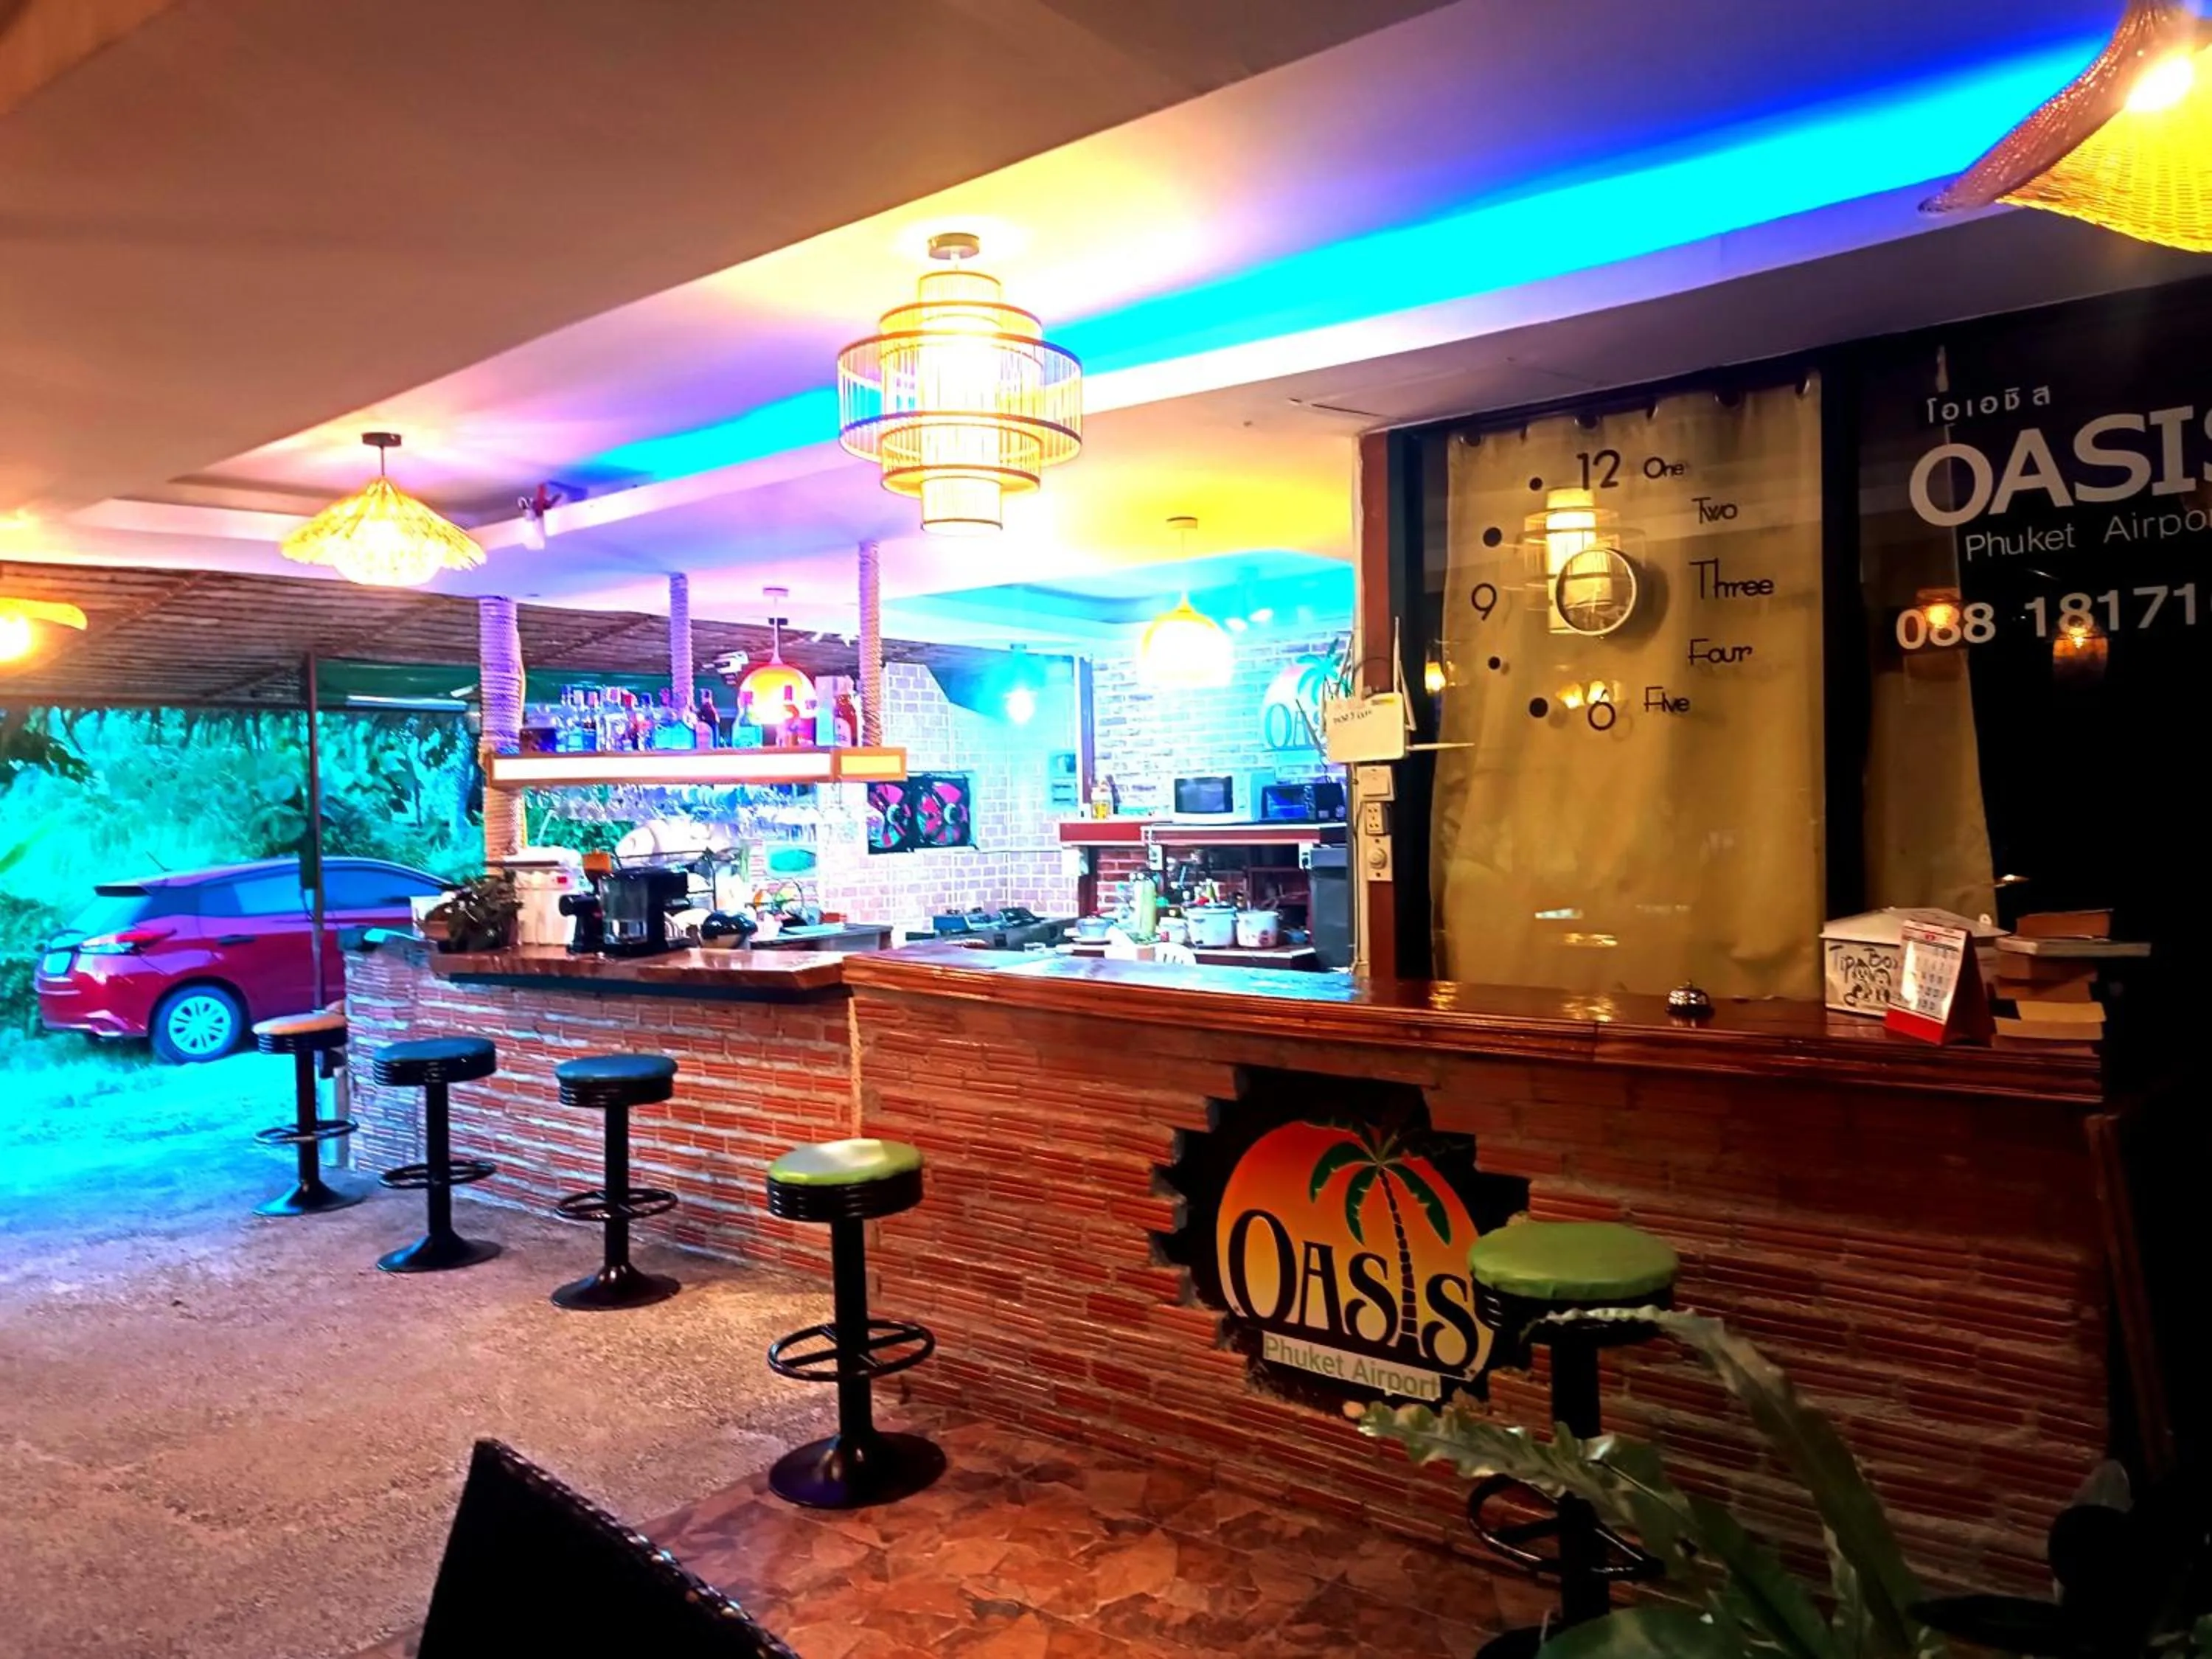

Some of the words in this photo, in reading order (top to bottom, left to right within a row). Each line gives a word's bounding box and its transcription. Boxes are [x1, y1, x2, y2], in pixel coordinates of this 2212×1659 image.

[1576, 449, 1621, 490] 12
[1643, 456, 1685, 479] One
[1909, 406, 2212, 527] OASI
[1691, 496, 1738, 525] Two
[1965, 524, 2076, 562] Phuket
[2103, 509, 2212, 544] Airpo
[1471, 582, 1498, 621] 9
[1688, 557, 1775, 601] Three
[1896, 601, 1997, 650] 088
[2024, 582, 2212, 639] 18171
[1687, 638, 1754, 666] Four
[1587, 689, 1617, 731] 6
[1643, 686, 1692, 714] Five
[1228, 1208, 1479, 1368] OASIS
[1264, 1333, 1345, 1378] Phuket
[1352, 1358, 1440, 1397] Airport
